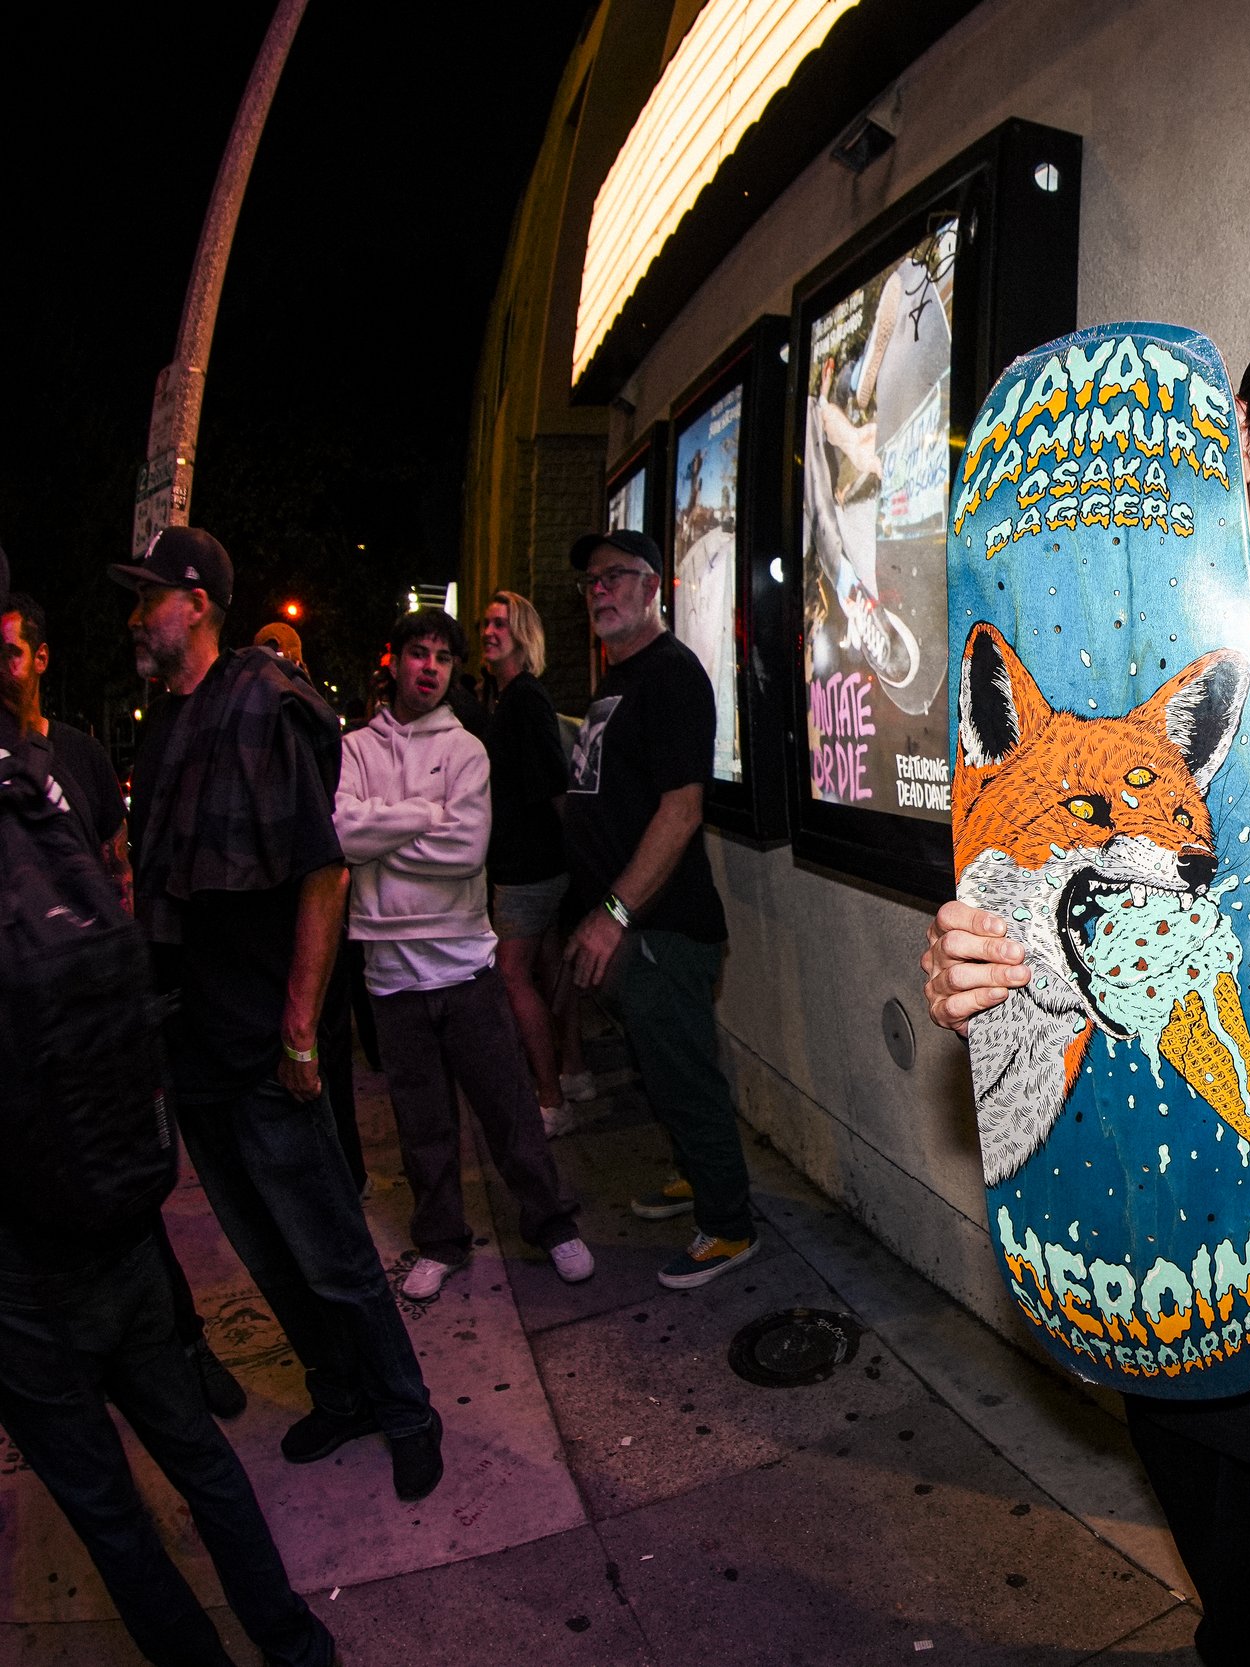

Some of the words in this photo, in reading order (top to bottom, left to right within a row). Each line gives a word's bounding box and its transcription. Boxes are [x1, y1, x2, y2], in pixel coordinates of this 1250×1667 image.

[963, 335, 1230, 483] HAYATE
[1017, 455, 1170, 509] OSAKA
[985, 492, 1194, 560] DAGGERS
[810, 672, 876, 740] MUTATE
[813, 743, 835, 793] OR
[835, 741, 873, 802] DIE
[896, 754, 949, 782] FEATURING
[896, 780, 924, 808] DEAD
[923, 785, 951, 810] DAVE
